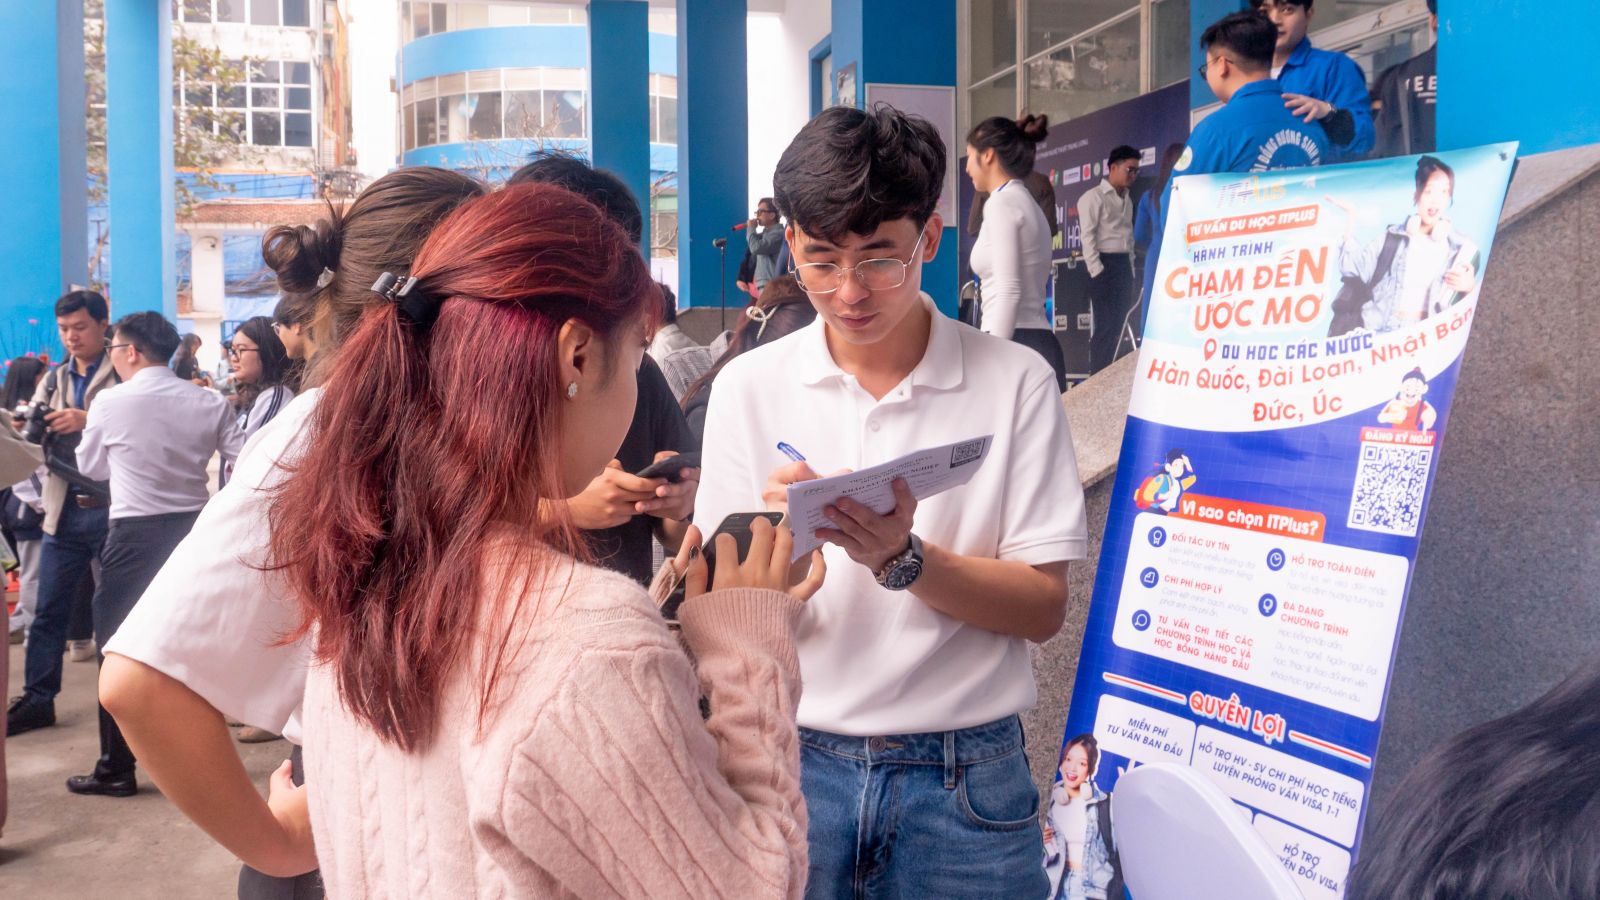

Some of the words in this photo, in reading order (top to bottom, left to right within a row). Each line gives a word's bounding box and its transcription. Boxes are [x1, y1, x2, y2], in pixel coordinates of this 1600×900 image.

[1190, 224, 1201, 237] TƯ
[1204, 218, 1228, 234] VẤN
[1229, 220, 1246, 231] DU
[1247, 215, 1276, 230] HỌC
[1278, 208, 1316, 225] ITPLUS
[1193, 246, 1226, 263] HÀNH
[1232, 240, 1274, 257] TRÌNH
[1165, 266, 1244, 299] CHẠM
[1253, 246, 1329, 290] ĐẾN
[1194, 292, 1254, 331] ƯỚC
[1262, 293, 1324, 325] MƠ
[1147, 358, 1190, 386] Hàn
[1196, 365, 1250, 393] Quốc,
[1258, 366, 1293, 388] Đài
[1302, 359, 1362, 383] Loan,
[1371, 332, 1427, 366] Nhật
[1435, 307, 1473, 340] Bản
[1222, 344, 1240, 359] DU
[1246, 345, 1279, 362] HỌC
[1285, 339, 1318, 360] CÁC
[1326, 331, 1373, 356] NƯỚC
[1253, 399, 1303, 422] Đức,
[1313, 388, 1342, 415] Úc
[1365, 429, 1394, 441] ĐĂNG
[1395, 431, 1409, 443] KÝ
[1409, 433, 1434, 446] NGAY
[1182, 499, 1196, 516] Vì
[1198, 506, 1224, 520] sao
[1227, 508, 1264, 529] chọn
[1267, 513, 1320, 536] ITPlus?
[1172, 532, 1187, 543] ĐỐI
[1188, 535, 1203, 546] TÁC
[1205, 540, 1216, 549] UY
[1218, 541, 1230, 551] TÍN
[1327, 561, 1352, 574] TOÀN
[1164, 575, 1178, 584] CHI
[1180, 577, 1193, 588] PHÍ
[1213, 584, 1223, 594] LÝ
[1283, 601, 1295, 611] ĐA
[1297, 604, 1325, 618] DẠNG
[1173, 617, 1190, 630] VẤN
[1195, 625, 1210, 635] CHI
[1215, 628, 1230, 641] TIẾT
[1235, 633, 1254, 646] CÁC
[1280, 614, 1320, 630] CHƯƠNG
[1322, 622, 1349, 636] TRÌNH
[1154, 637, 1173, 650] HỌC
[1176, 641, 1200, 657] BỔNG
[1203, 651, 1228, 665] HÀNG
[1232, 656, 1250, 671] ĐẦU
[1156, 627, 1192, 643] CHƯƠNG
[1194, 635, 1216, 649] TRÌNH
[1218, 643, 1237, 656] HỌC
[1240, 647, 1251, 659] VÀ
[1128, 717, 1150, 732] MIỄN
[1152, 726, 1168, 738] PHÍ
[1190, 692, 1249, 727] QUYỀN
[1253, 709, 1283, 740] LỢI
[1107, 724, 1120, 735] TƯ
[1122, 727, 1140, 742] VẤN
[1143, 736, 1162, 749] BAN
[1163, 741, 1183, 757] ĐẦU
[1198, 740, 1213, 754] HỖ
[1215, 747, 1232, 761] TRỢ
[1233, 755, 1247, 767] HV
[1253, 762, 1267, 774] SV
[1268, 768, 1287, 782] CHI
[1288, 773, 1307, 789] PHÍ
[1307, 783, 1330, 799] HỌC
[1332, 790, 1358, 813] TIẾNG,
[1213, 761, 1241, 779] LUYỆN
[1241, 772, 1277, 793] PHỎNG
[1279, 786, 1300, 802] VẤN
[1302, 795, 1323, 812] VISA
[1326, 804, 1340, 818] 1-1
[1283, 842, 1300, 856] HỖ
[1301, 850, 1321, 868] TRỢ
[1298, 865, 1317, 881] ĐỔI
[1319, 875, 1338, 893] VISA
